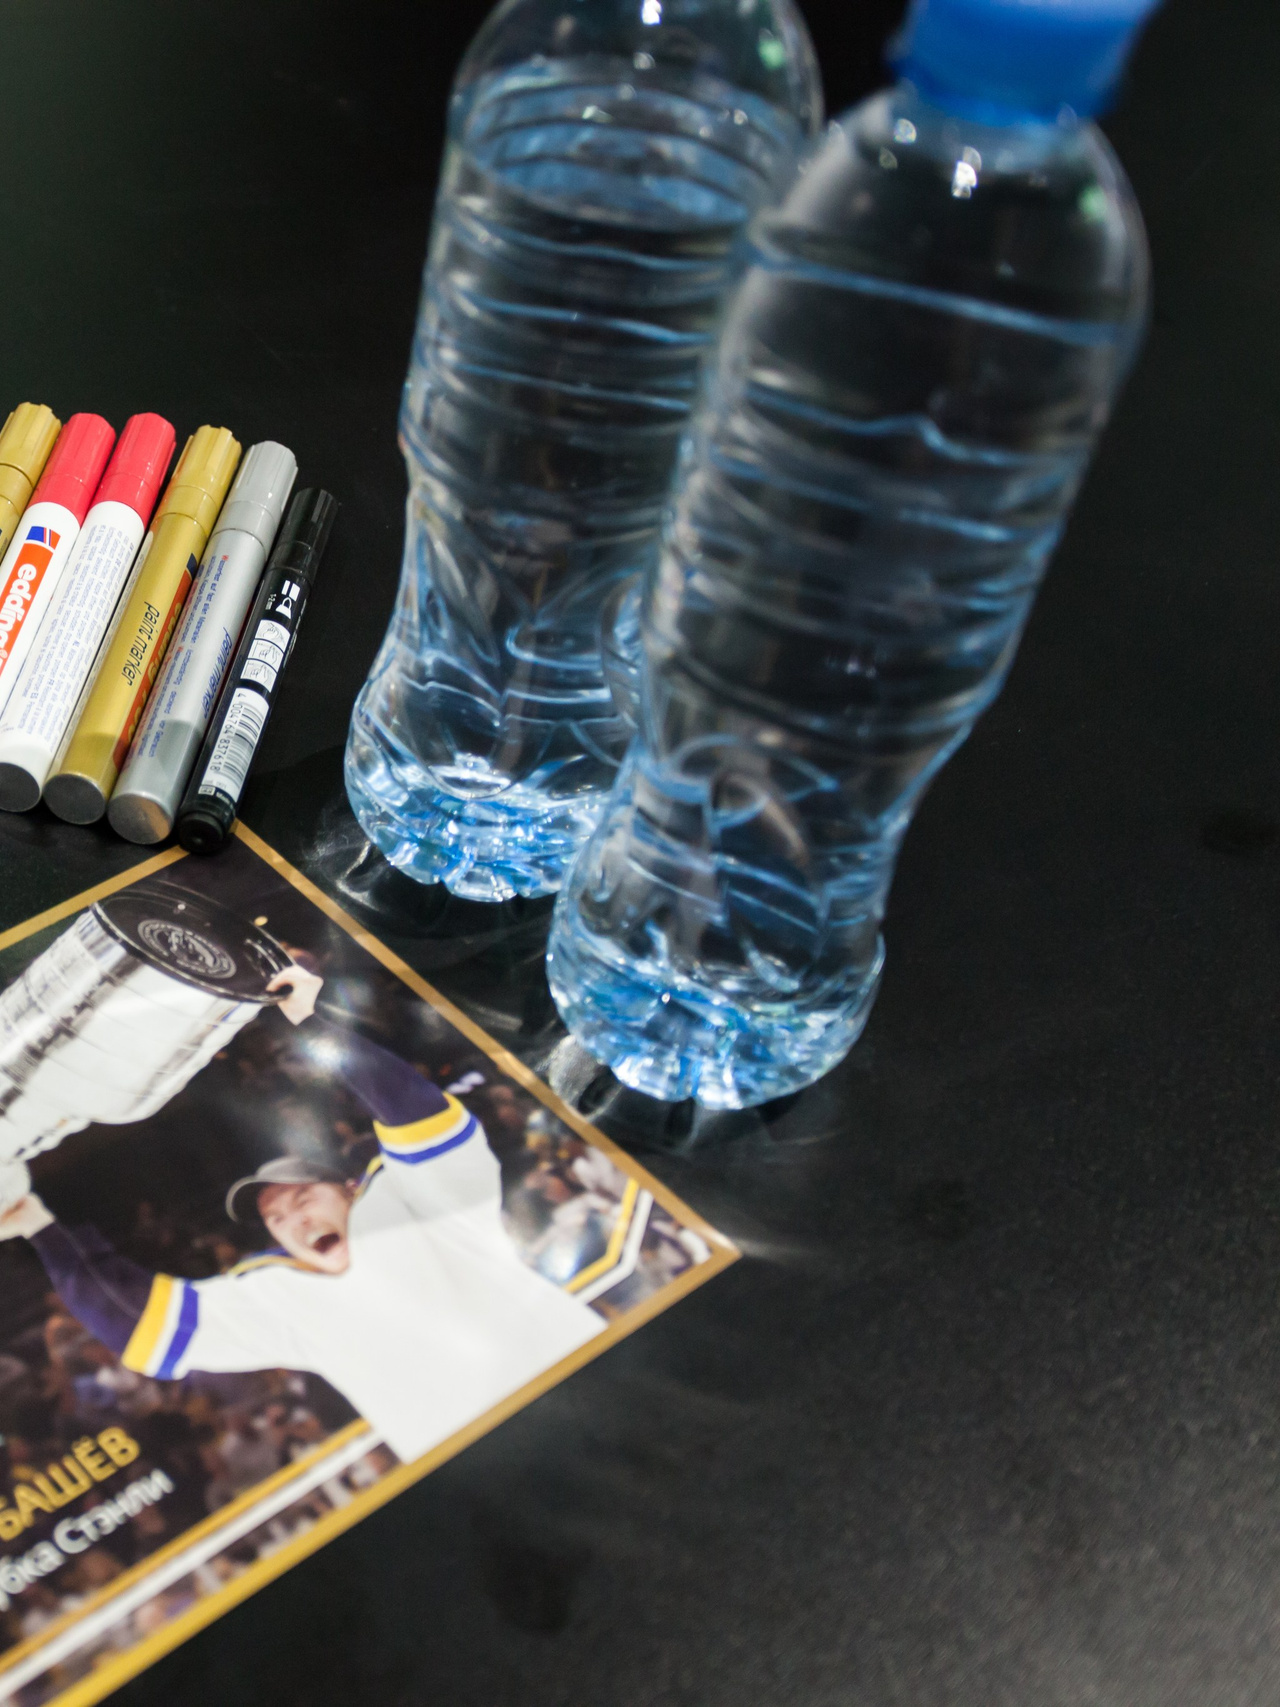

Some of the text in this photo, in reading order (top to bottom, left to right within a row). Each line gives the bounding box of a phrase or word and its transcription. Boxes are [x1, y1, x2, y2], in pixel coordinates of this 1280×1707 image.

[144, 601, 160, 640] paint
[121, 635, 148, 686] marker
[53, 1469, 175, 1554] Стэнли
